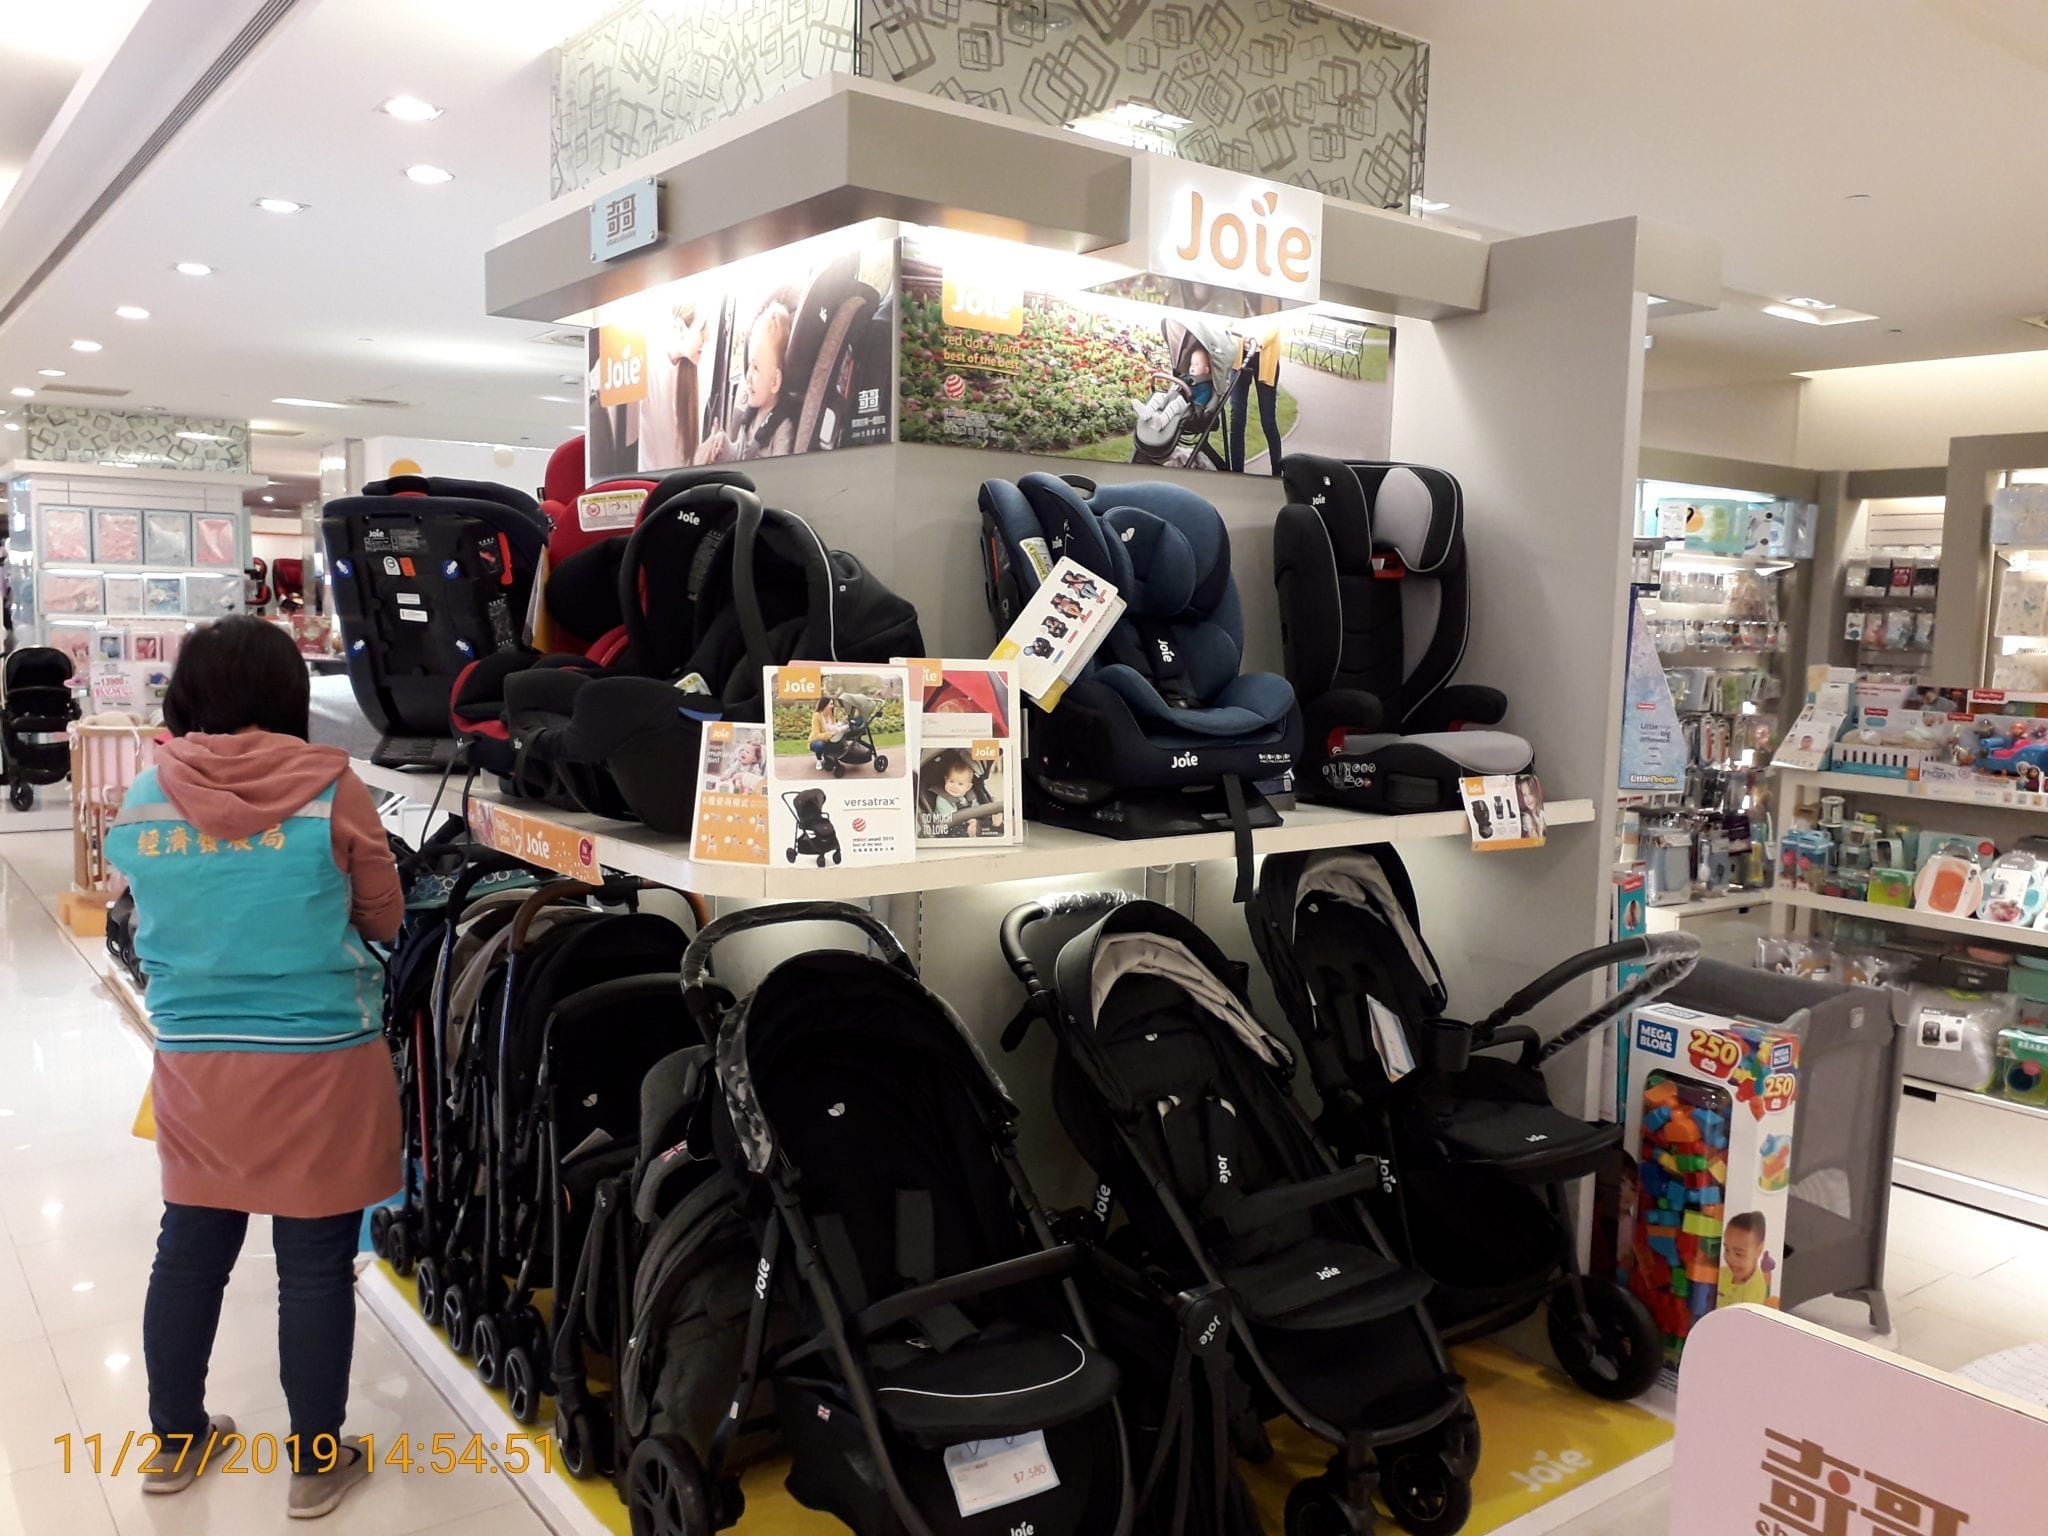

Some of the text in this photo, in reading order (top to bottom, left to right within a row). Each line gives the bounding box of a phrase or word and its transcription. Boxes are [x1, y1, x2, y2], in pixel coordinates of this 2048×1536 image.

[1176, 191, 1313, 283] Joie
[943, 333, 1021, 356] red dot award
[604, 344, 642, 391] Joie
[943, 348, 1020, 371] best of the best
[1312, 493, 1327, 507] Joie
[677, 510, 701, 526] Joie
[368, 528, 385, 538] Joie
[1157, 638, 1176, 664] Joie
[783, 677, 816, 695] Joie
[712, 728, 731, 738] Joie
[975, 746, 996, 757] Joie
[1171, 751, 1199, 769] Joie
[843, 797, 896, 807] versatrax
[922, 814, 932, 824] SO
[923, 825, 931, 835] TO
[526, 831, 550, 860] Joie
[1639, 1023, 1673, 1043] MEGA
[1639, 1034, 1673, 1053] BLOKS
[1688, 1029, 1740, 1067] 250
[1764, 1075, 1794, 1098] 250
[1216, 1153, 1230, 1185] Joie
[1378, 1155, 1397, 1194] Joie
[1094, 1183, 1112, 1222] Joie
[755, 1257, 771, 1300] Joie
[1316, 1265, 1341, 1282] Joie
[1199, 1313, 1221, 1346] Joie
[1508, 1446, 1593, 1493] Joie
[1010, 1521, 1035, 1536] Joie
